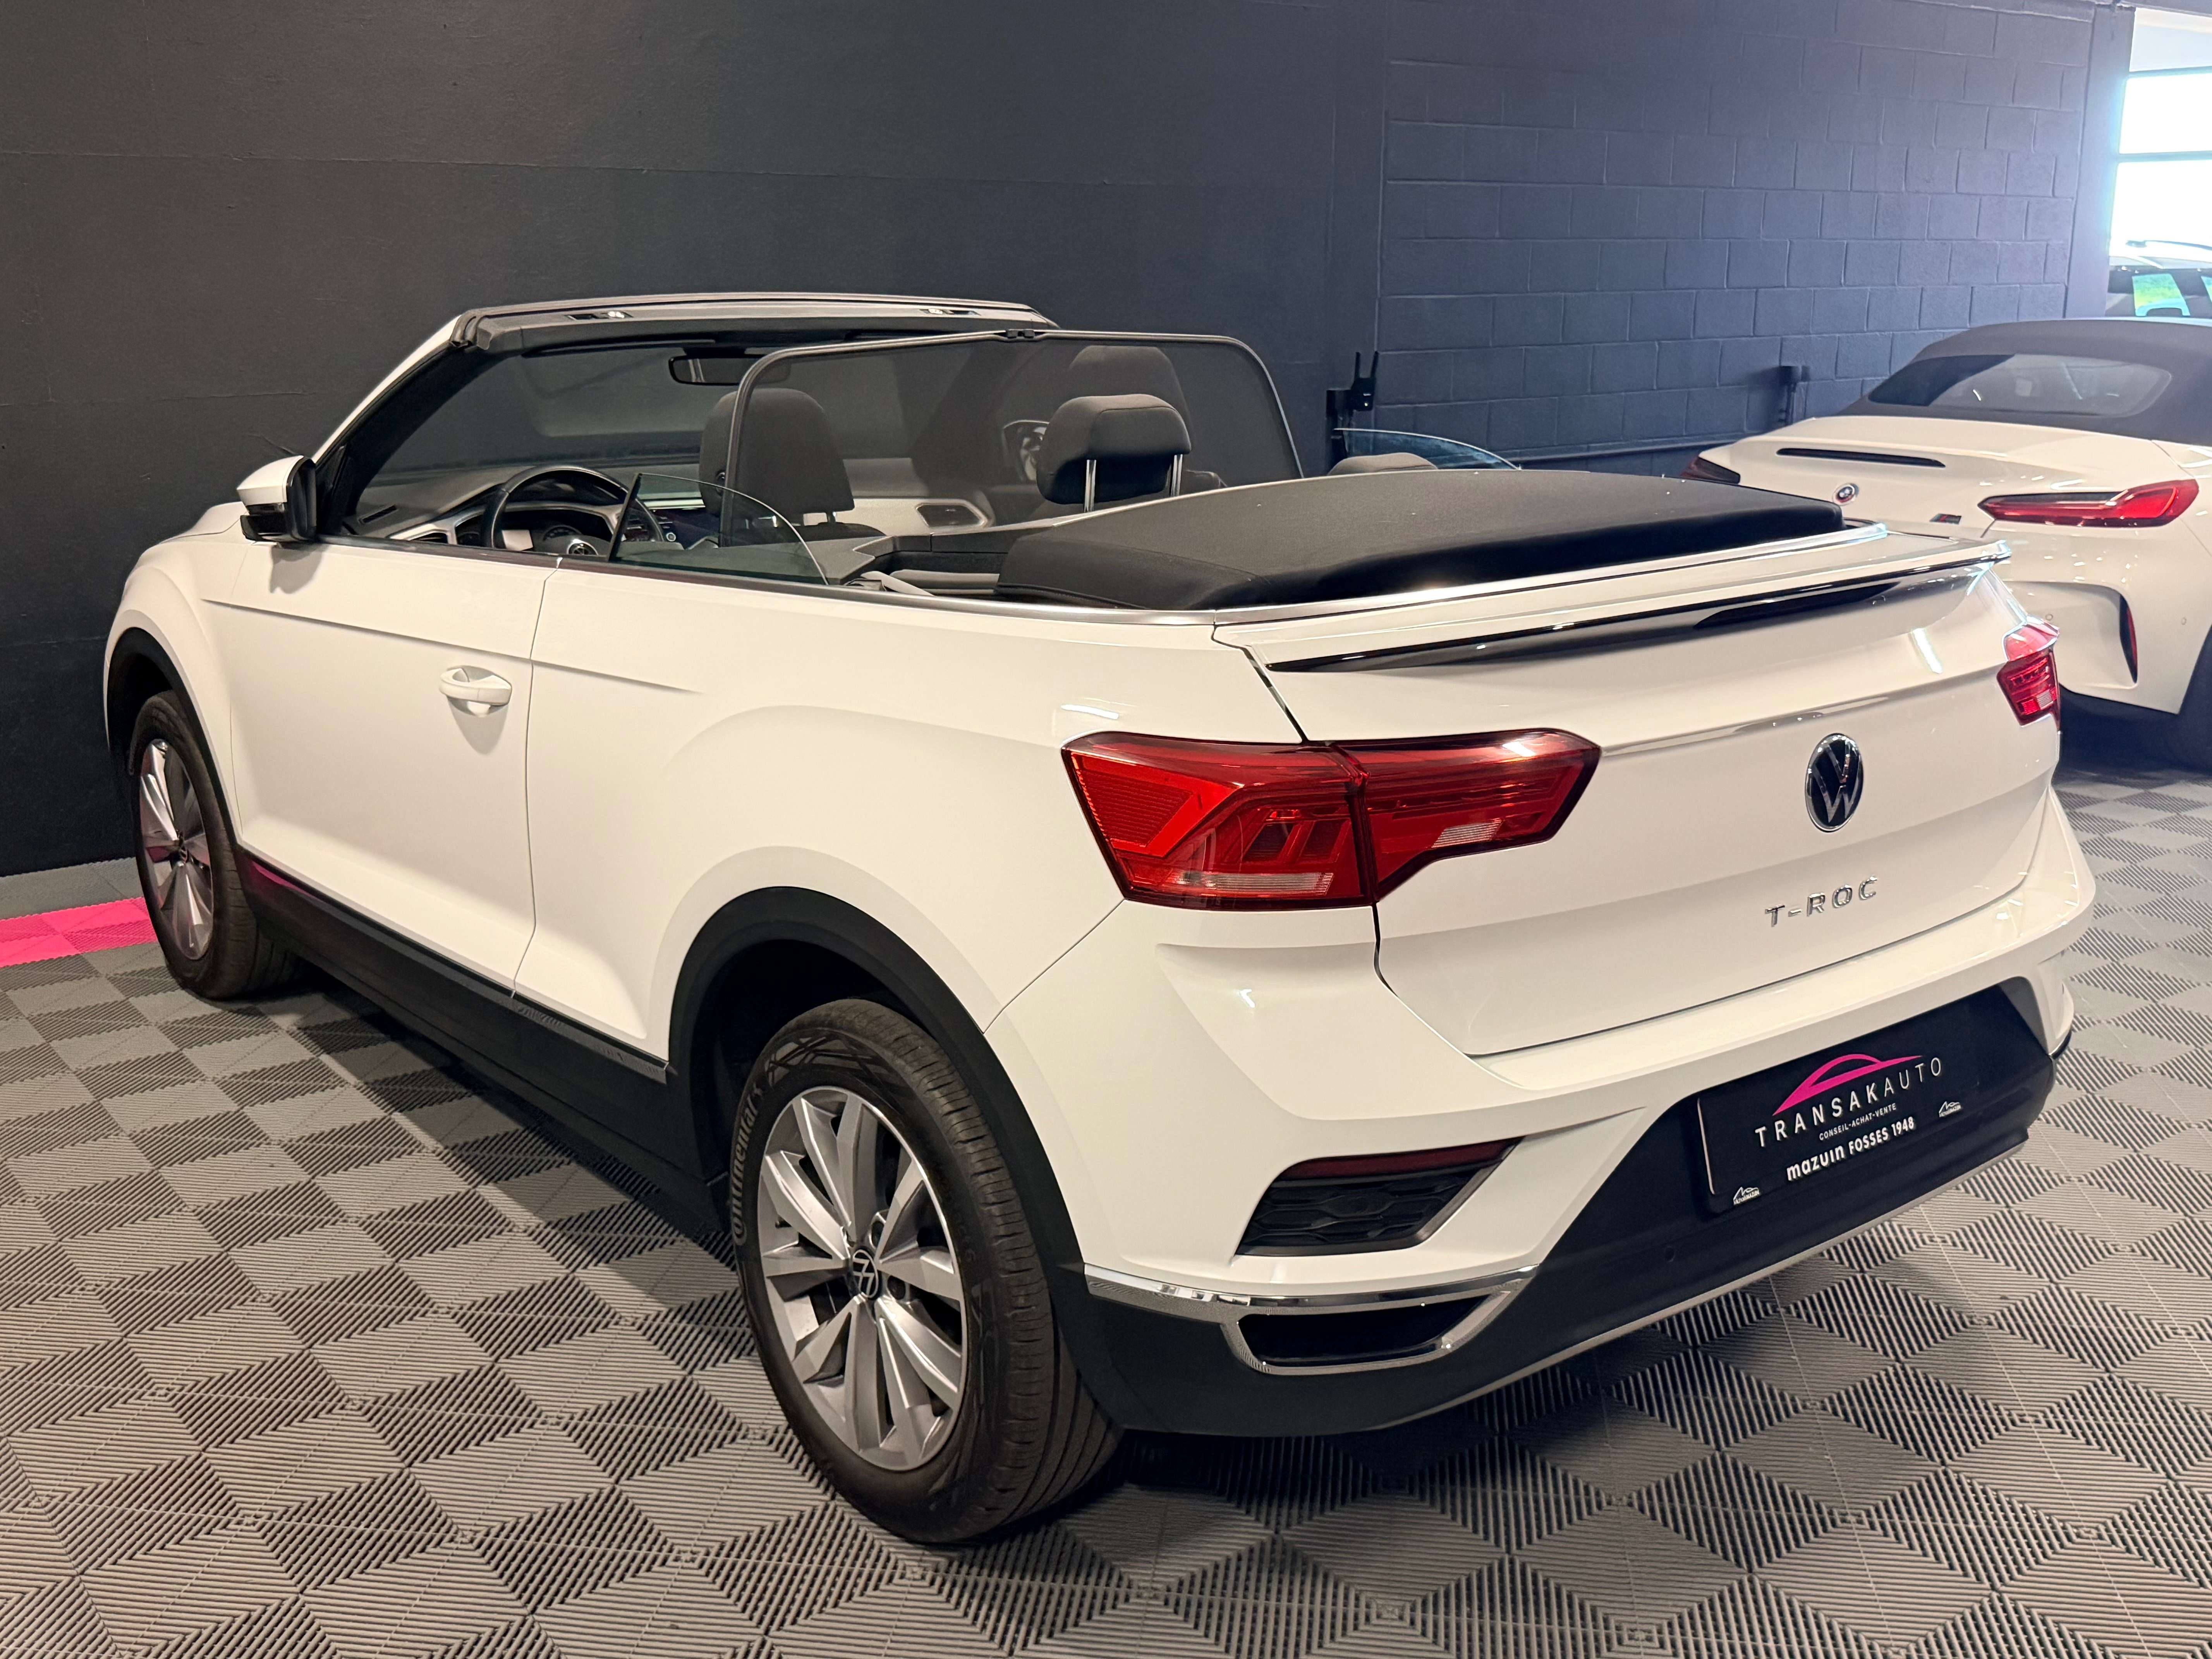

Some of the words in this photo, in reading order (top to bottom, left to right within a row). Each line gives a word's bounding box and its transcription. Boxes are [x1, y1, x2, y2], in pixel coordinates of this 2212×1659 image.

[1807, 734, 1862, 829] VW
[1765, 876, 1878, 927] T-ROC
[1755, 1057, 1941, 1147] TRANSAKAUTO
[1819, 1103, 1897, 1140] CONSEIL-ACHAT-VENTE
[1848, 1127, 1889, 1155] FOSSES
[1891, 1116, 1915, 1136] 1948
[732, 1094, 758, 1246] Continental
